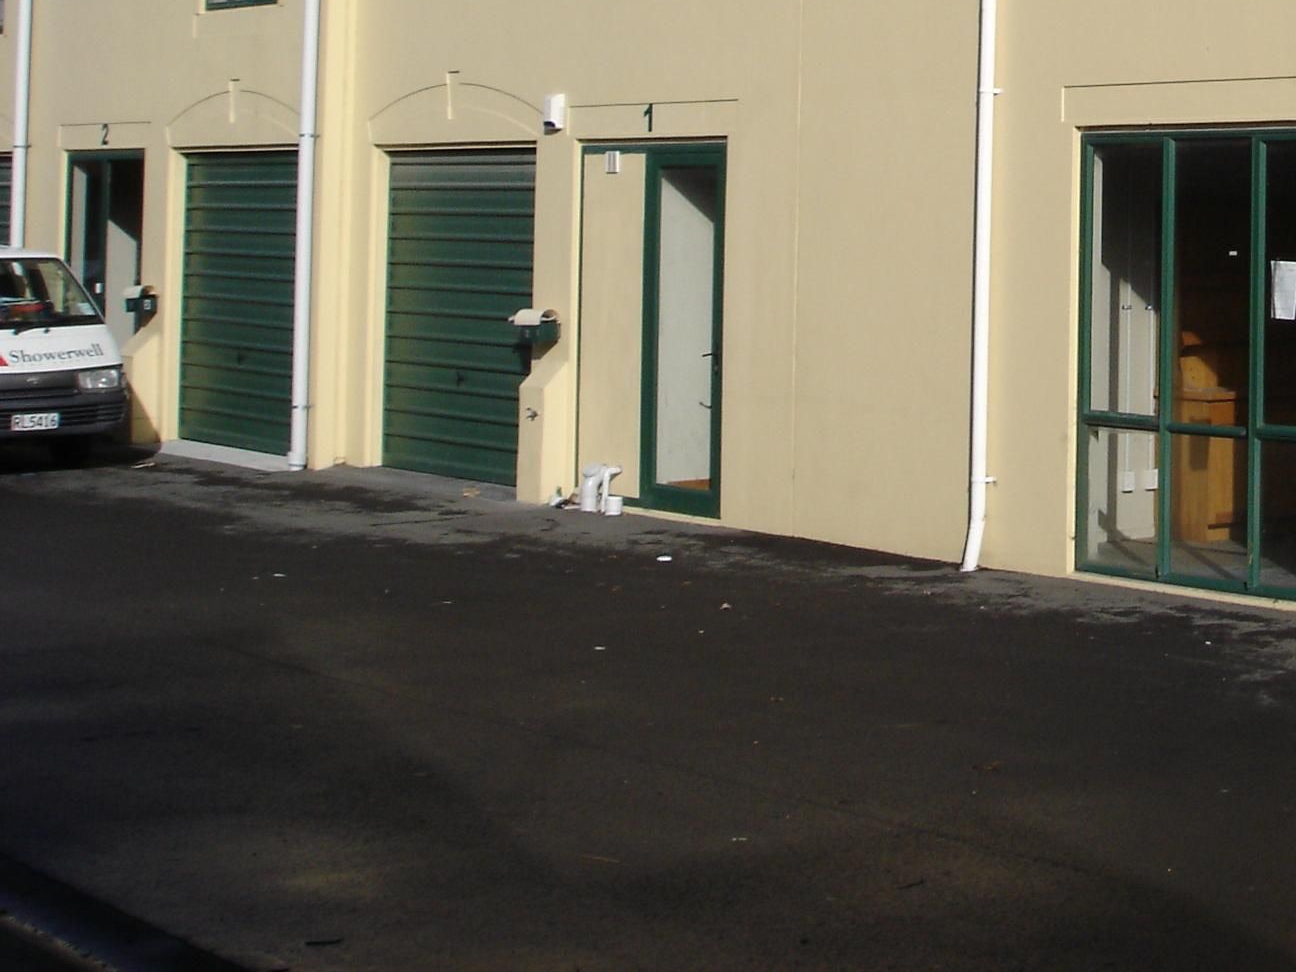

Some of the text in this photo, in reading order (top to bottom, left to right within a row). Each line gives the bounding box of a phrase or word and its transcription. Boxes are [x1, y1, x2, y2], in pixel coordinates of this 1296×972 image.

[643, 103, 653, 132] 1
[101, 123, 109, 146] 2
[9, 343, 104, 363] Showerwell
[13, 414, 57, 428] RL5416
